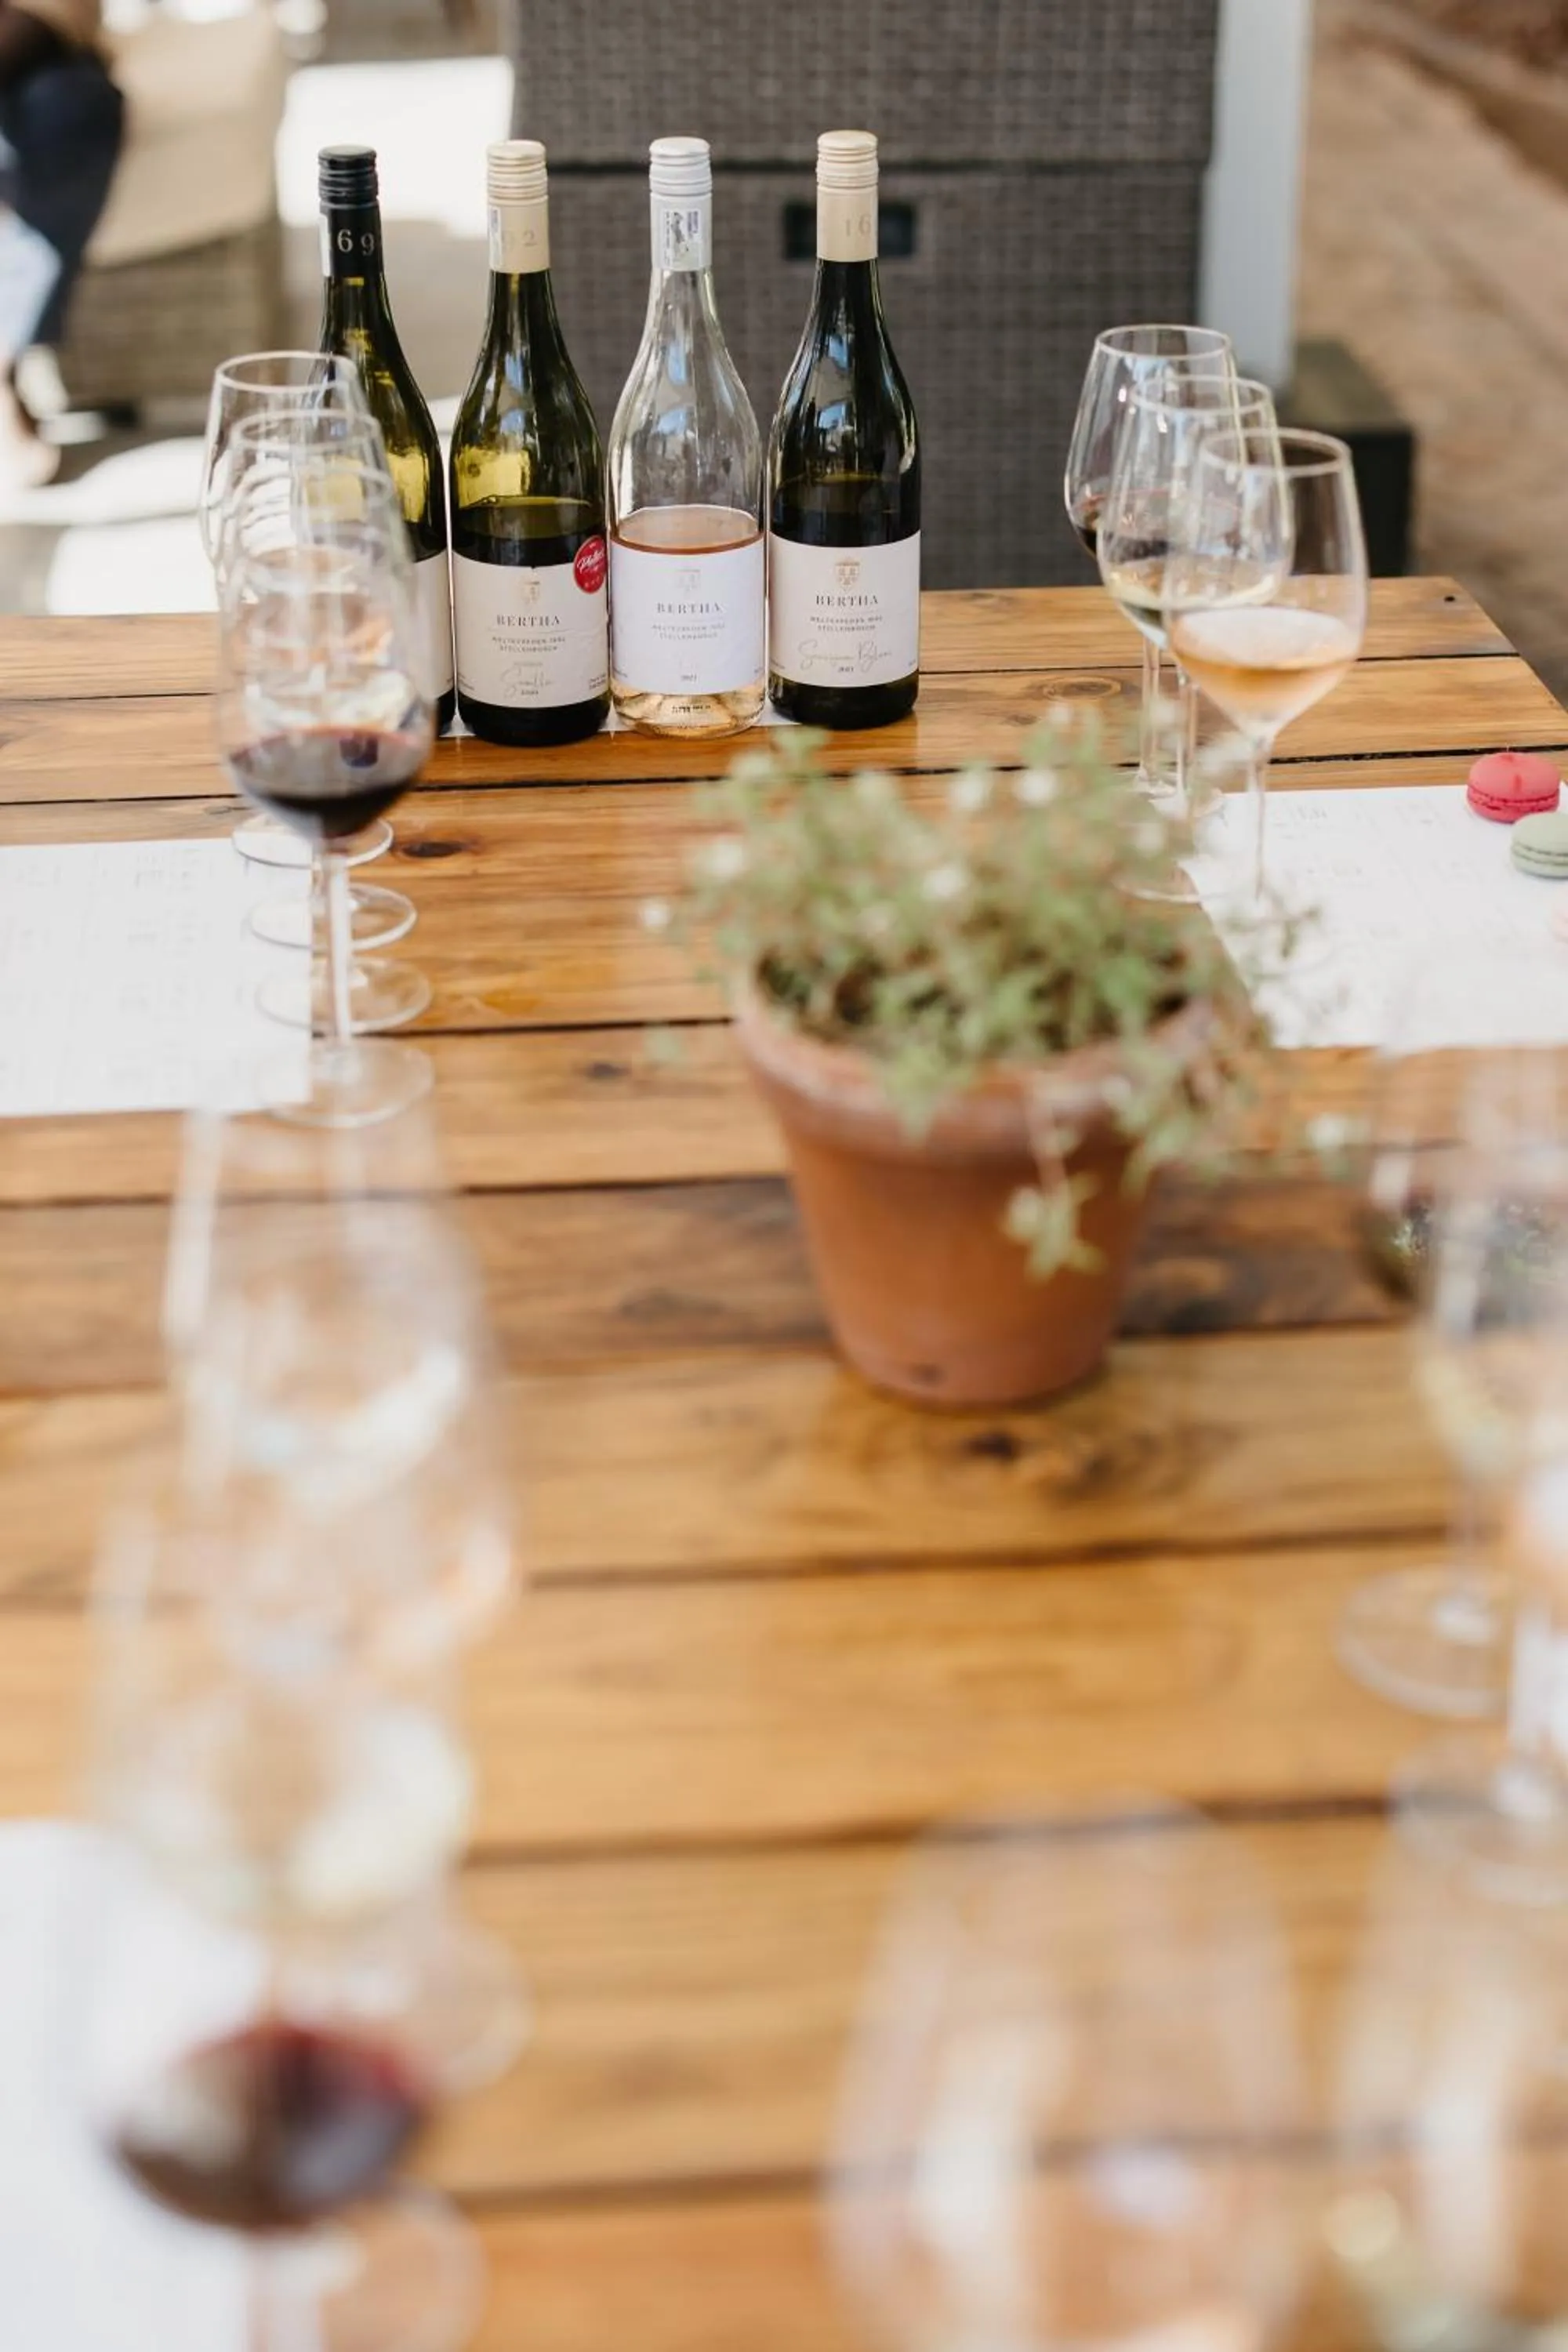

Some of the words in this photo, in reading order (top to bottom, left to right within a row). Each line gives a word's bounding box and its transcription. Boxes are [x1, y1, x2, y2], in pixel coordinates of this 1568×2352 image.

[815, 594, 879, 606] BERTHA
[656, 602, 724, 615] BERTHA
[496, 614, 561, 626] BERTHA
